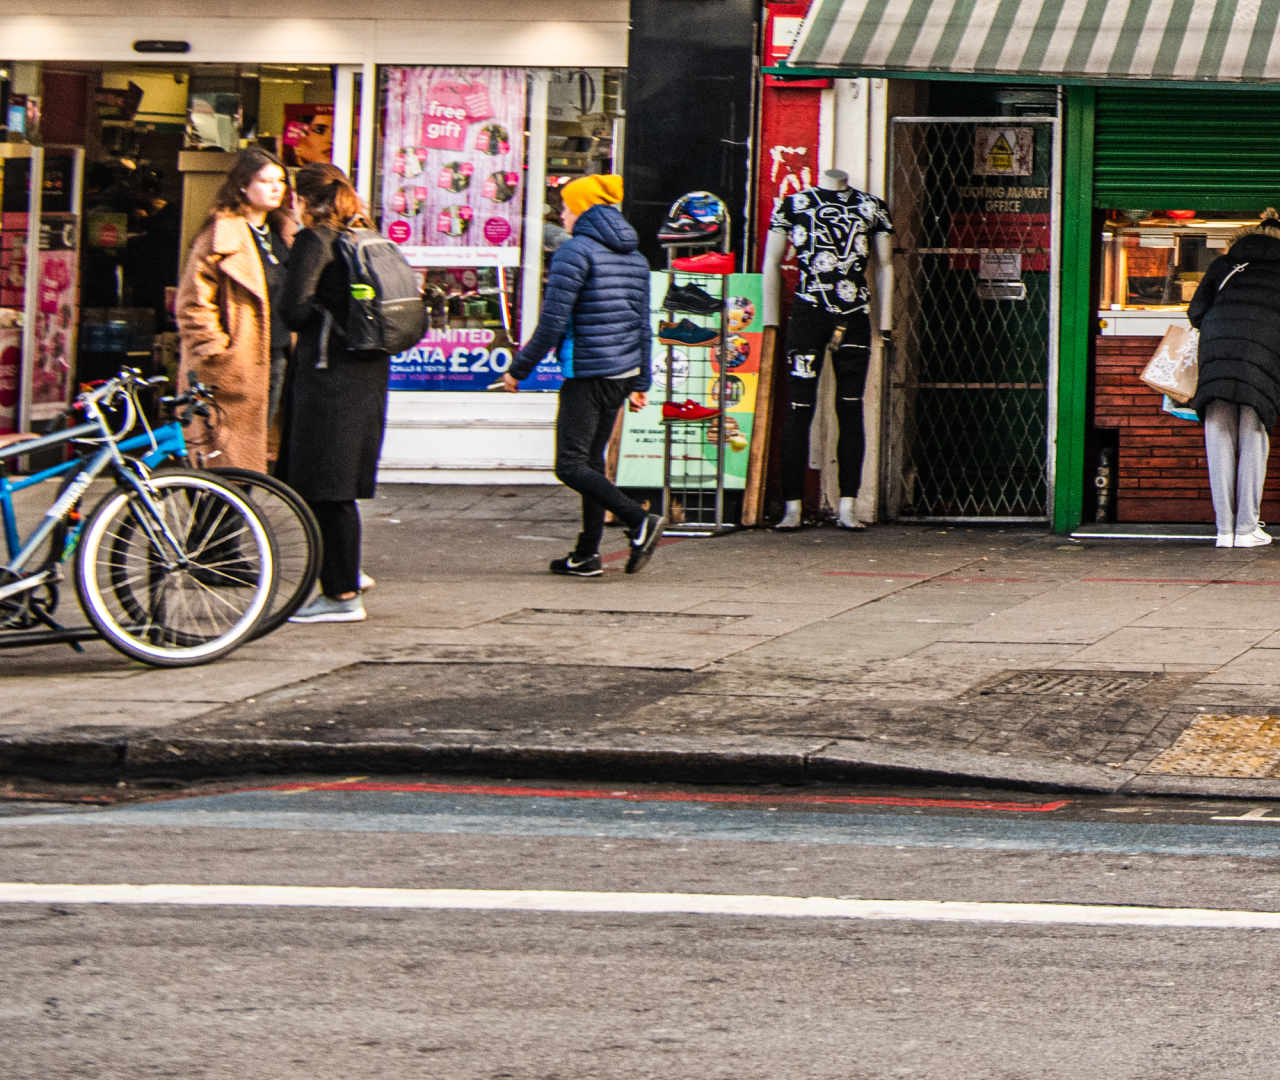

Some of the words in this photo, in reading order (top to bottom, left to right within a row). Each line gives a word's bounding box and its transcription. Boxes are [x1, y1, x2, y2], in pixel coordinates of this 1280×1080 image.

[429, 100, 466, 120] free
[426, 120, 461, 139] gift
[985, 201, 1021, 212] OFFICE
[449, 346, 513, 373] £20
